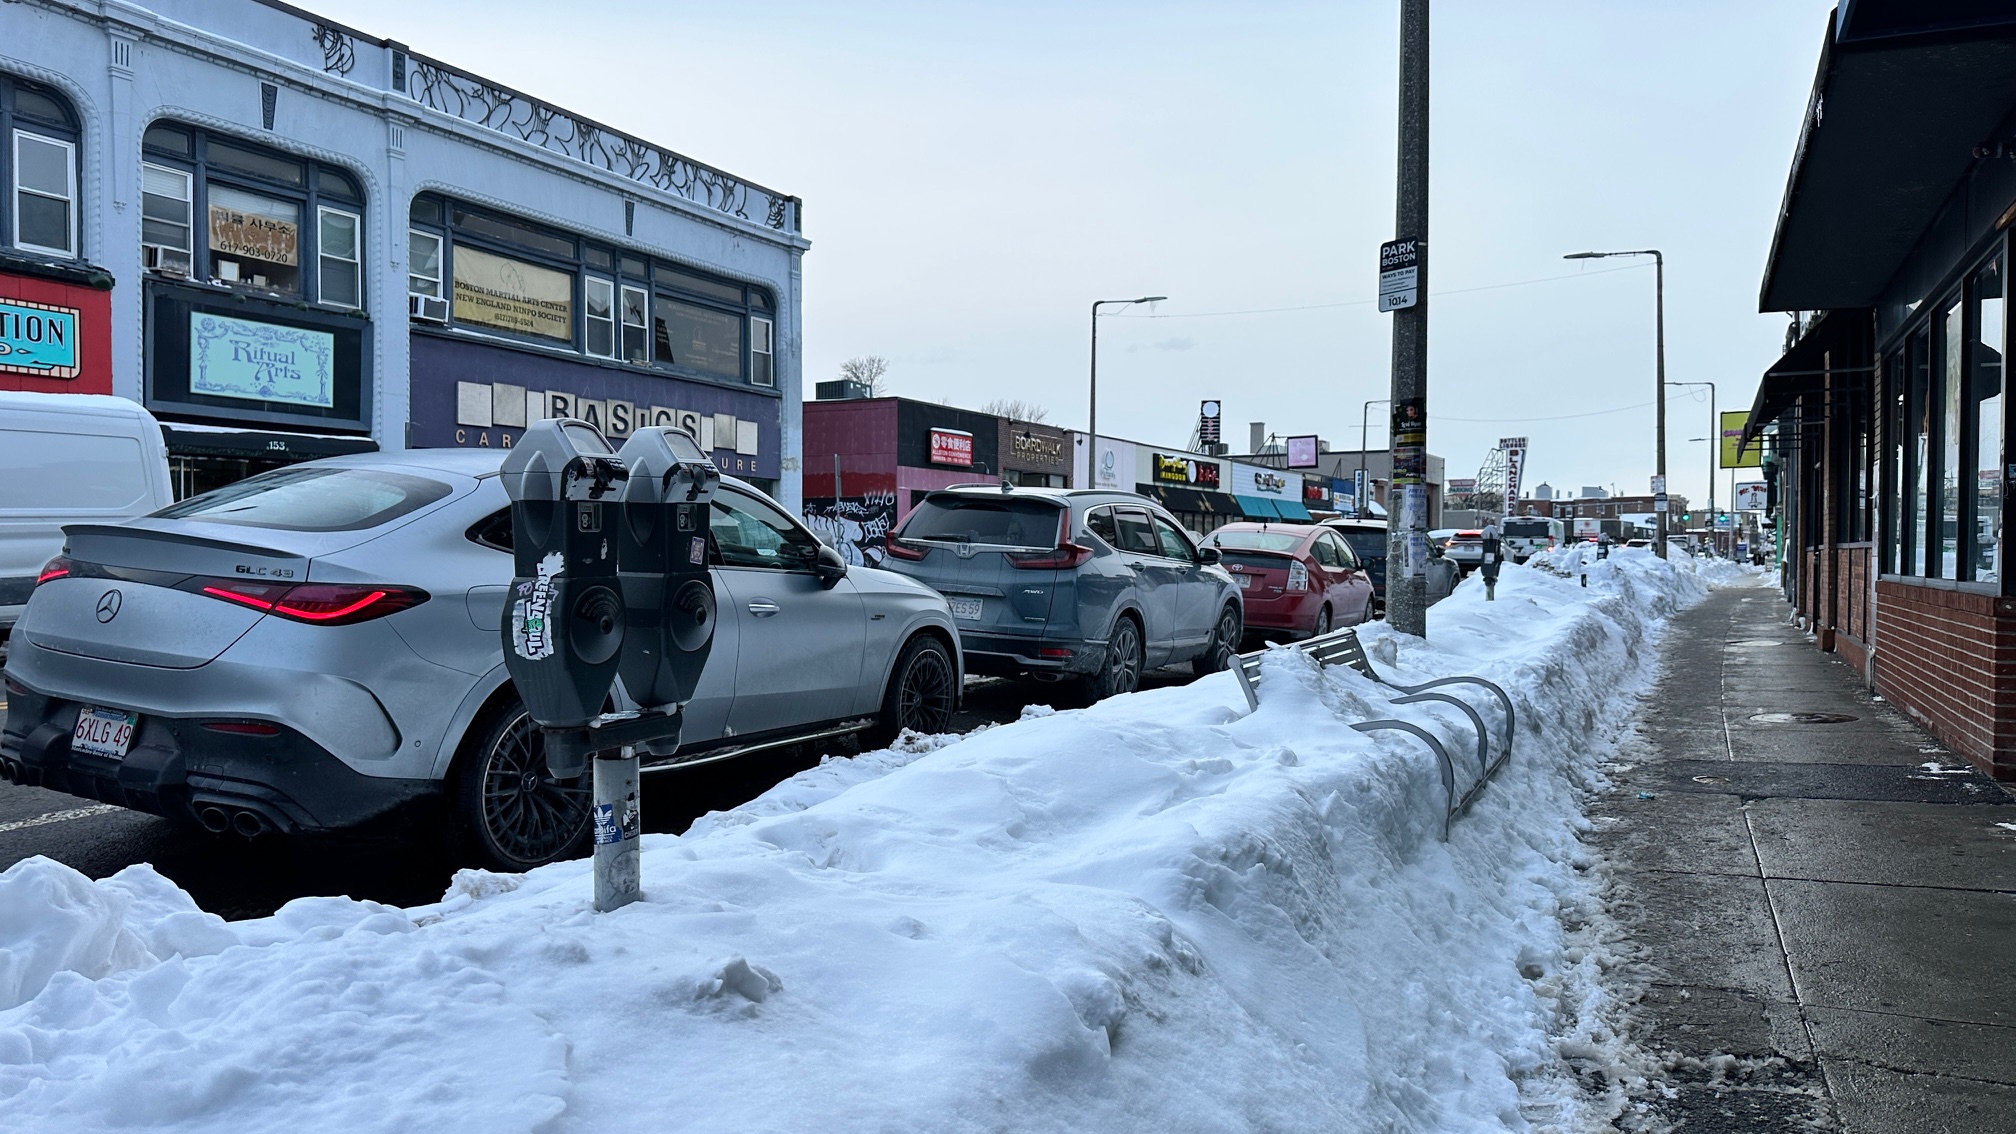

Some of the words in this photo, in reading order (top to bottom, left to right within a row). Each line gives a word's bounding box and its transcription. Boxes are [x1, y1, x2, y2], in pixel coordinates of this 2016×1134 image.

[249, 218, 291, 236] 사무소
[220, 240, 288, 263] 617-903-0720
[1382, 240, 1416, 258] PARK
[1382, 252, 1416, 267] BOSTON
[1382, 272, 1397, 280] WAYS
[1405, 268, 1416, 276] PAY
[454, 280, 485, 295] BOSTON
[486, 288, 520, 302] MARTIAL
[522, 296, 540, 307] ARTS
[540, 300, 568, 313] CENTER
[1388, 295, 1408, 307] 1014
[455, 293, 475, 304] NEW
[476, 297, 512, 312] ENGLAND
[513, 305, 537, 318] NINPO
[537, 311, 567, 324] SOCIETY
[229, 339, 296, 365] Ritual
[254, 361, 301, 384] Arts
[551, 395, 697, 439] BASICS
[268, 440, 286, 451] 153
[455, 429, 511, 448] CAR
[1015, 435, 1061, 455] BOARDWALK
[710, 456, 757, 472] URE
[1016, 452, 1060, 465] PROPERTIES
[235, 564, 267, 576] GLC
[270, 568, 294, 579] 43
[968, 603, 980, 616] 59
[75, 717, 112, 744] 6XLG
[112, 724, 132, 747] 49
